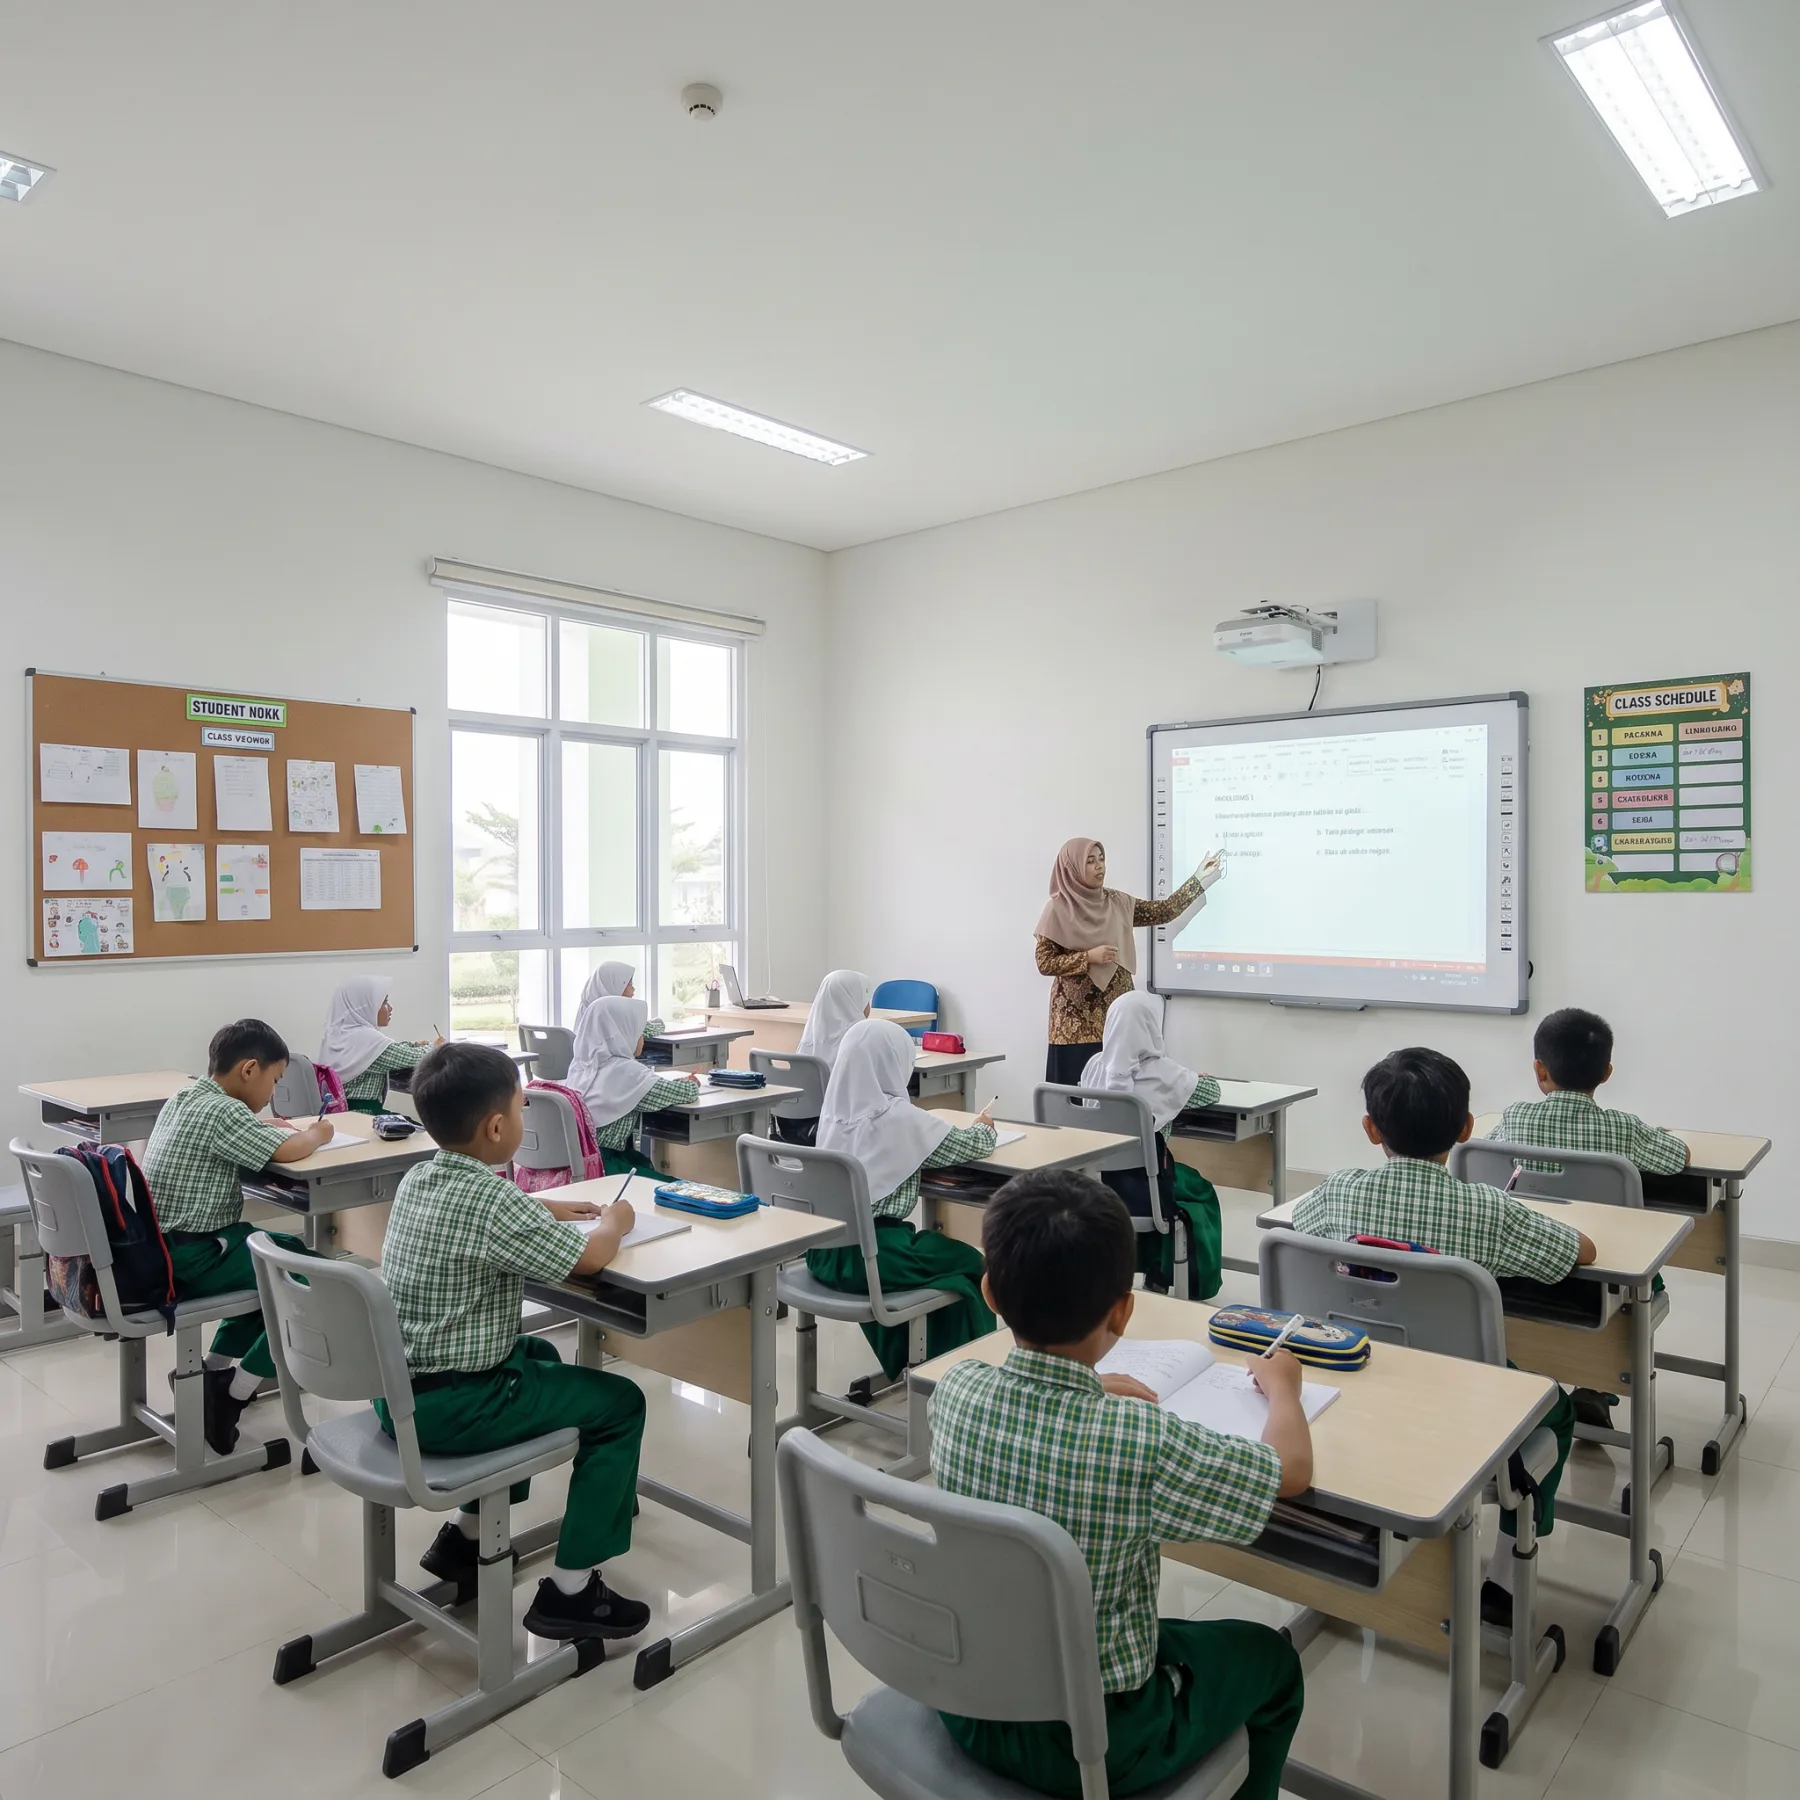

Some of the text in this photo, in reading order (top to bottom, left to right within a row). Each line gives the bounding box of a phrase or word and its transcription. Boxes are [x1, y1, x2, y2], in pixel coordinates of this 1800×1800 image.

[1614, 689, 1717, 710] CLASS SCHEDULE
[192, 700, 280, 720] STUDENT NOKK
[207, 732, 233, 742] CLASS
